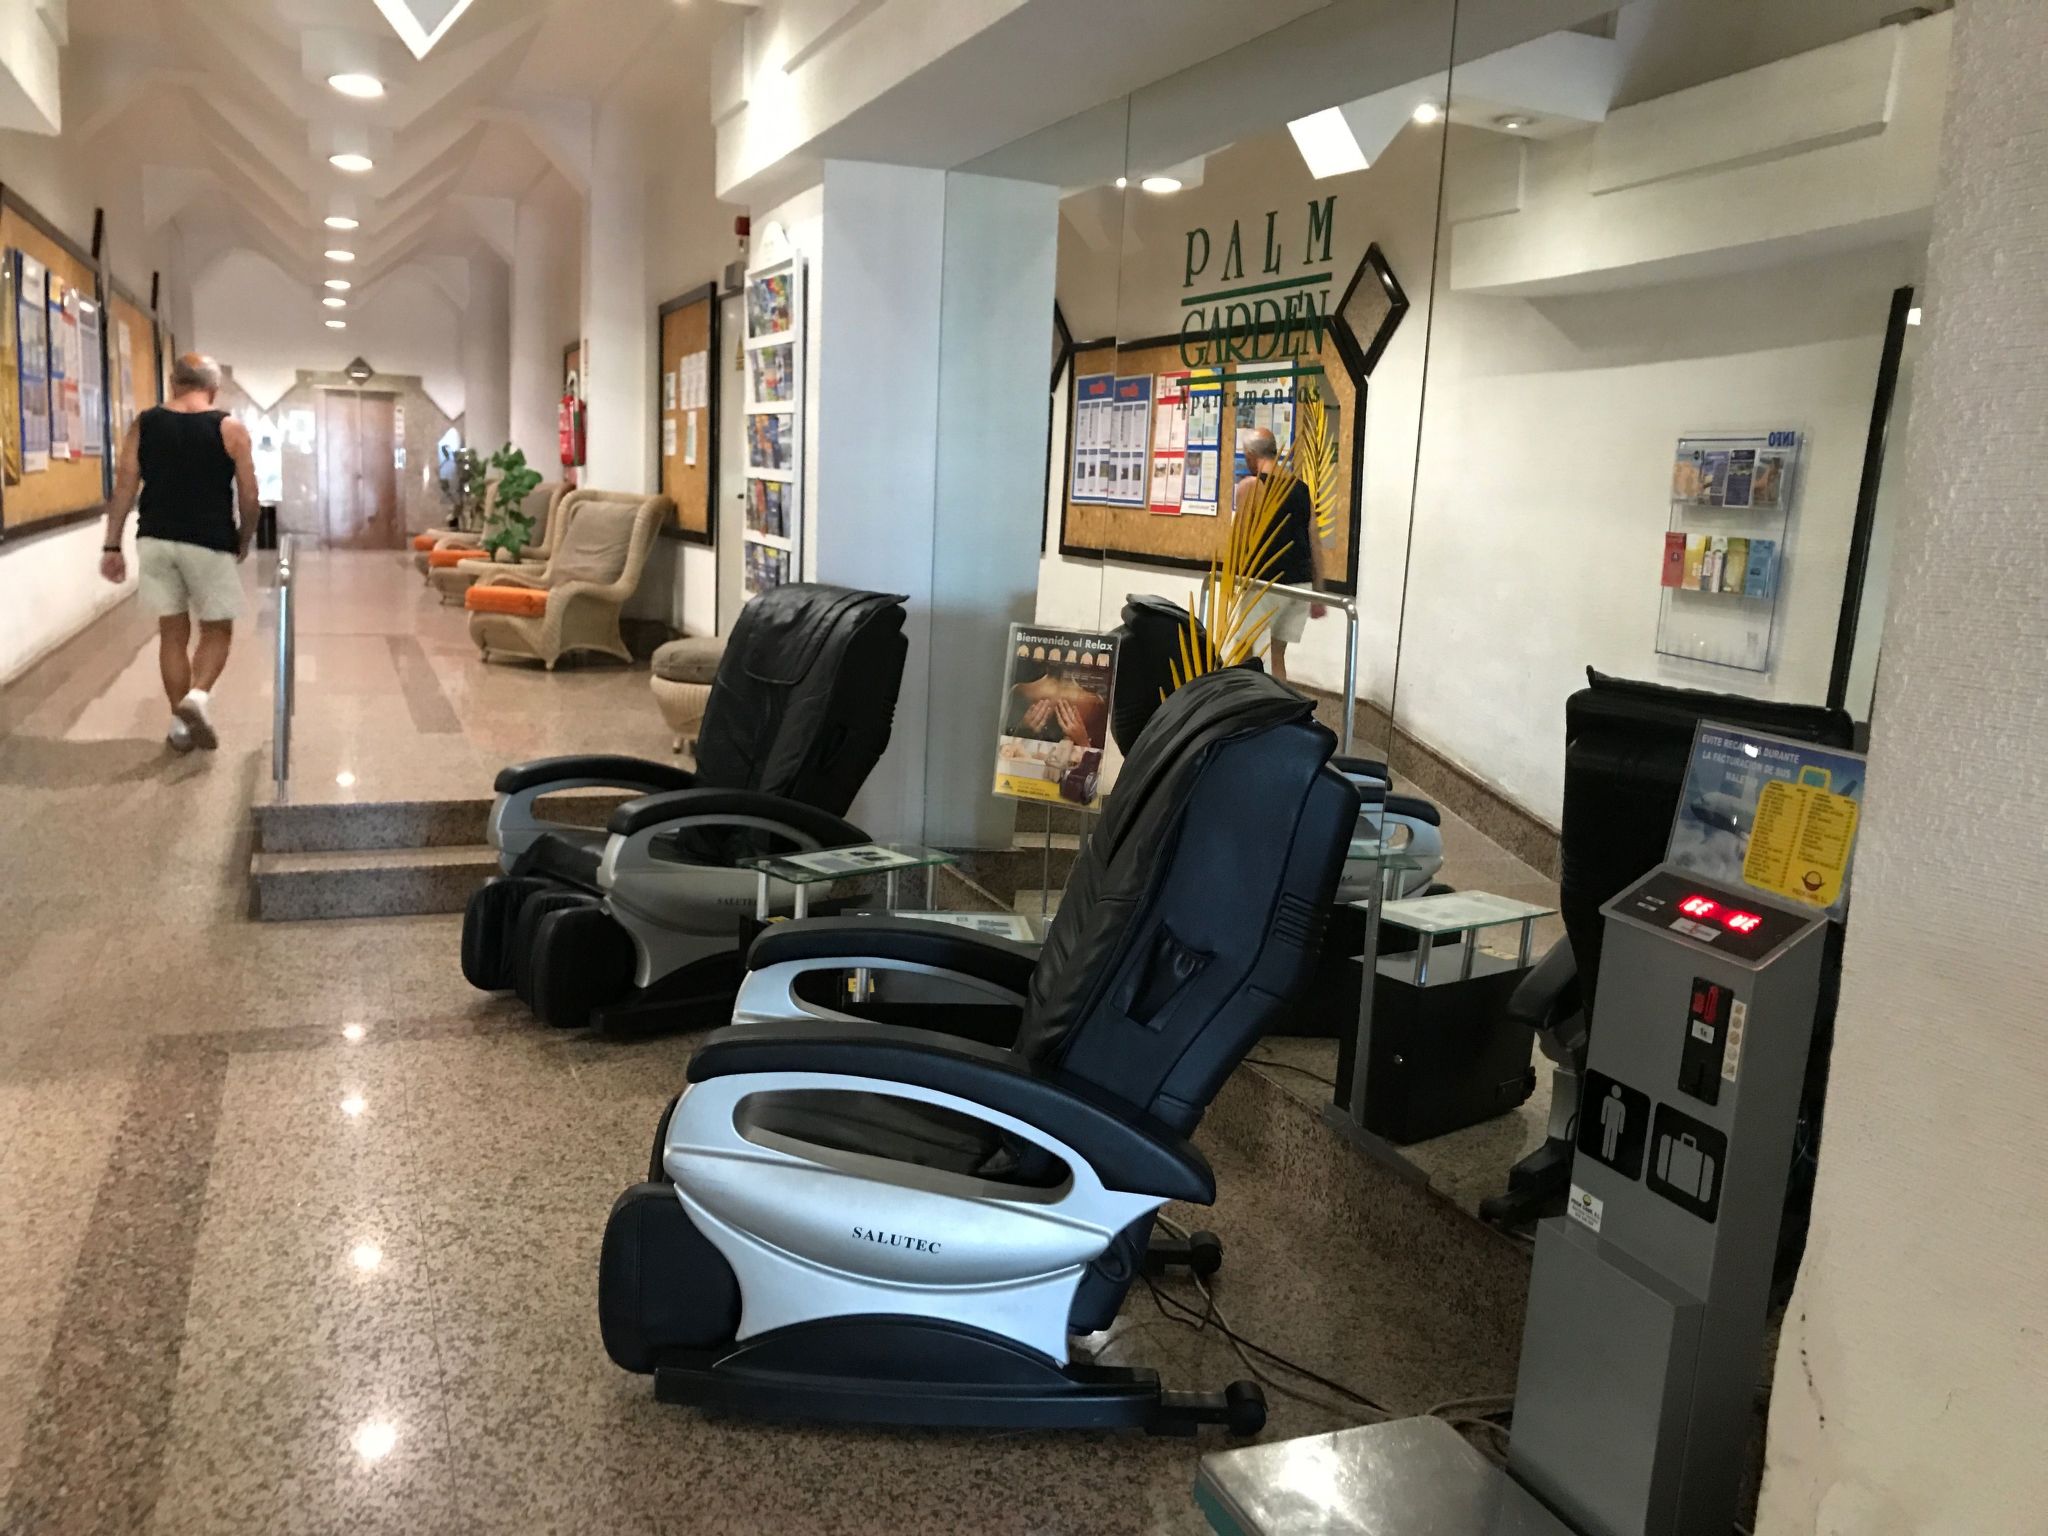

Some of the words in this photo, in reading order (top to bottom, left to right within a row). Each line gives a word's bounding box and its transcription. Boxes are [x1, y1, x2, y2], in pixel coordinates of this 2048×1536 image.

[1182, 196, 1338, 287] PALM
[1179, 290, 1331, 369] GARDEN
[1016, 632, 1070, 646] Bienvenido
[1072, 638, 1082, 648] al
[1085, 639, 1113, 651] Relax
[1701, 734, 1723, 747] EVITE
[1763, 747, 1801, 764] DURANTE
[1702, 751, 1711, 760] LA
[851, 1226, 942, 1254] SALUTEC
